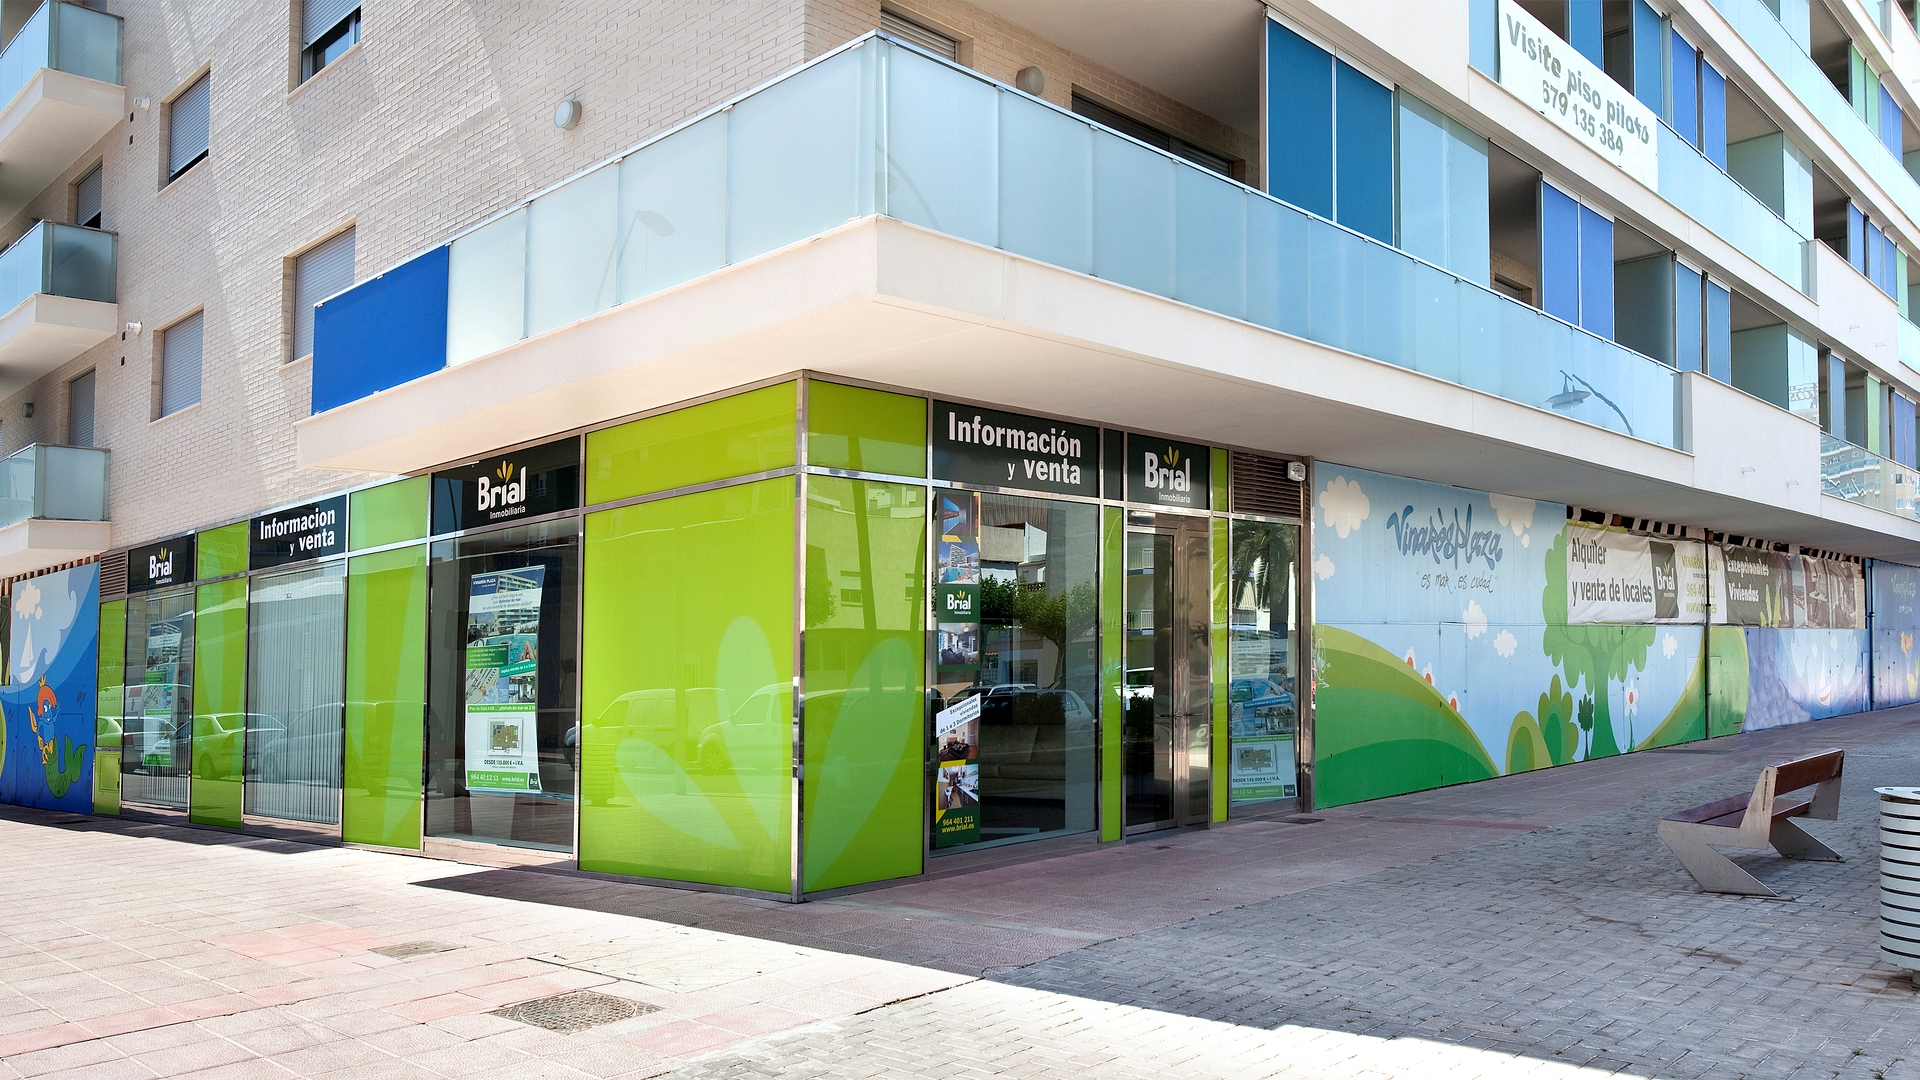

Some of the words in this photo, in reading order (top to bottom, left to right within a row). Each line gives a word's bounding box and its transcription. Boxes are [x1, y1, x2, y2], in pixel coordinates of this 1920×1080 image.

[1506, 12, 1562, 78] Visite
[1567, 68, 1601, 110] piso
[1607, 99, 1649, 145] piloto
[1542, 80, 1568, 117] 679
[1572, 103, 1595, 138] 135
[1600, 123, 1623, 156] 384
[949, 411, 1081, 458] Información
[1007, 463, 1015, 480] y
[1024, 459, 1081, 485] venta
[1144, 451, 1190, 492] Brial
[477, 466, 526, 511] Brial
[1159, 491, 1191, 504] Inmobiliaria
[260, 508, 335, 540] Informacion
[490, 505, 526, 519] Inmobiliaria
[289, 543, 295, 557] y
[299, 529, 335, 552] venta
[1571, 537, 1607, 569] Alquiler
[149, 551, 172, 579] Brial
[1655, 566, 1675, 590] Brial
[1727, 555, 1769, 577] Excepcionales
[947, 593, 971, 610] Brial
[1572, 583, 1578, 606] y
[1580, 580, 1607, 602] venta
[1608, 578, 1620, 602] de
[1621, 577, 1653, 603] locales
[1728, 582, 1759, 602] Viviendas
[950, 698, 977, 714] Excepcionales
[956, 710, 979, 725] Dormitorios
[960, 704, 978, 716] viviendas
[942, 823, 974, 833] www.brial.es
